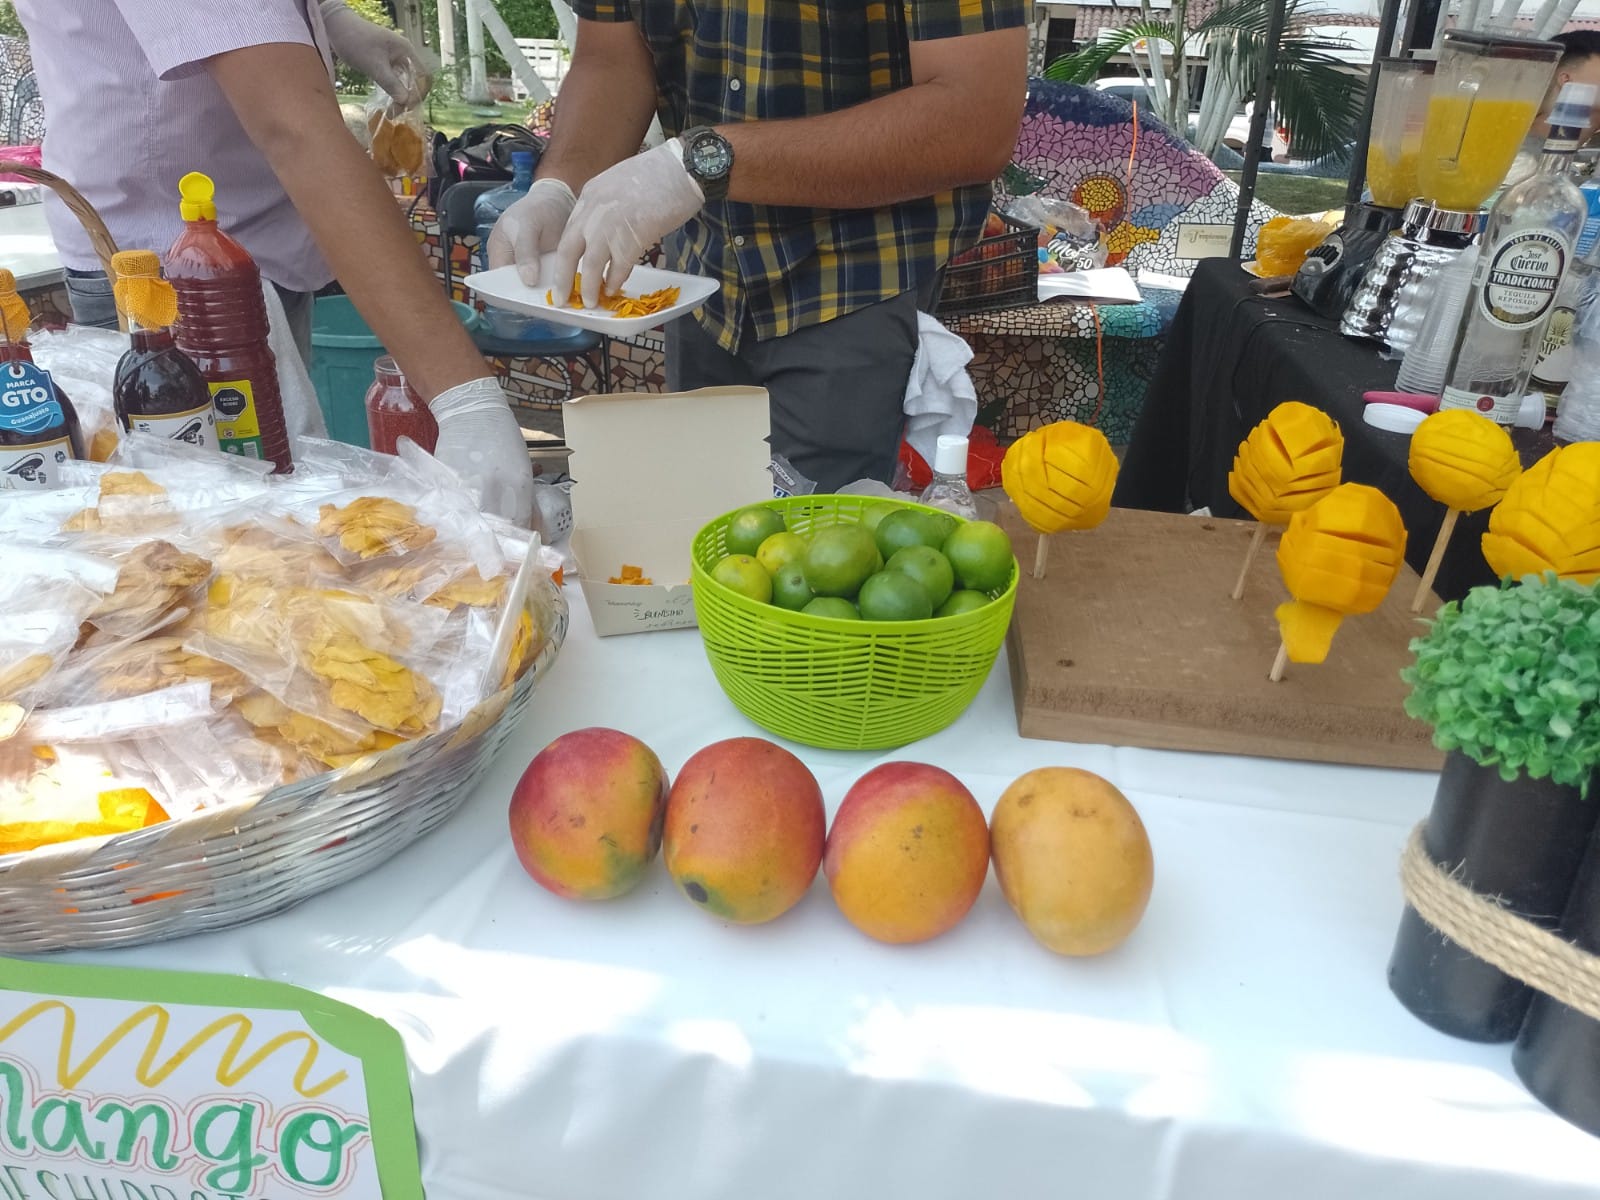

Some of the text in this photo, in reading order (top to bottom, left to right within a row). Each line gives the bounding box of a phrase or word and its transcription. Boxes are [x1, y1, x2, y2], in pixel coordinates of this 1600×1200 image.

[1076, 257, 1093, 270] 50
[1511, 254, 1549, 272] Cuervo
[1493, 271, 1554, 289] TRADICIONAL
[1497, 295, 1538, 306] REPOSADO
[1504, 289, 1536, 299] TEQUILA
[6, 379, 36, 389] MARCA
[2, 386, 48, 408] GTO
[10, 407, 50, 425] Guanajuato
